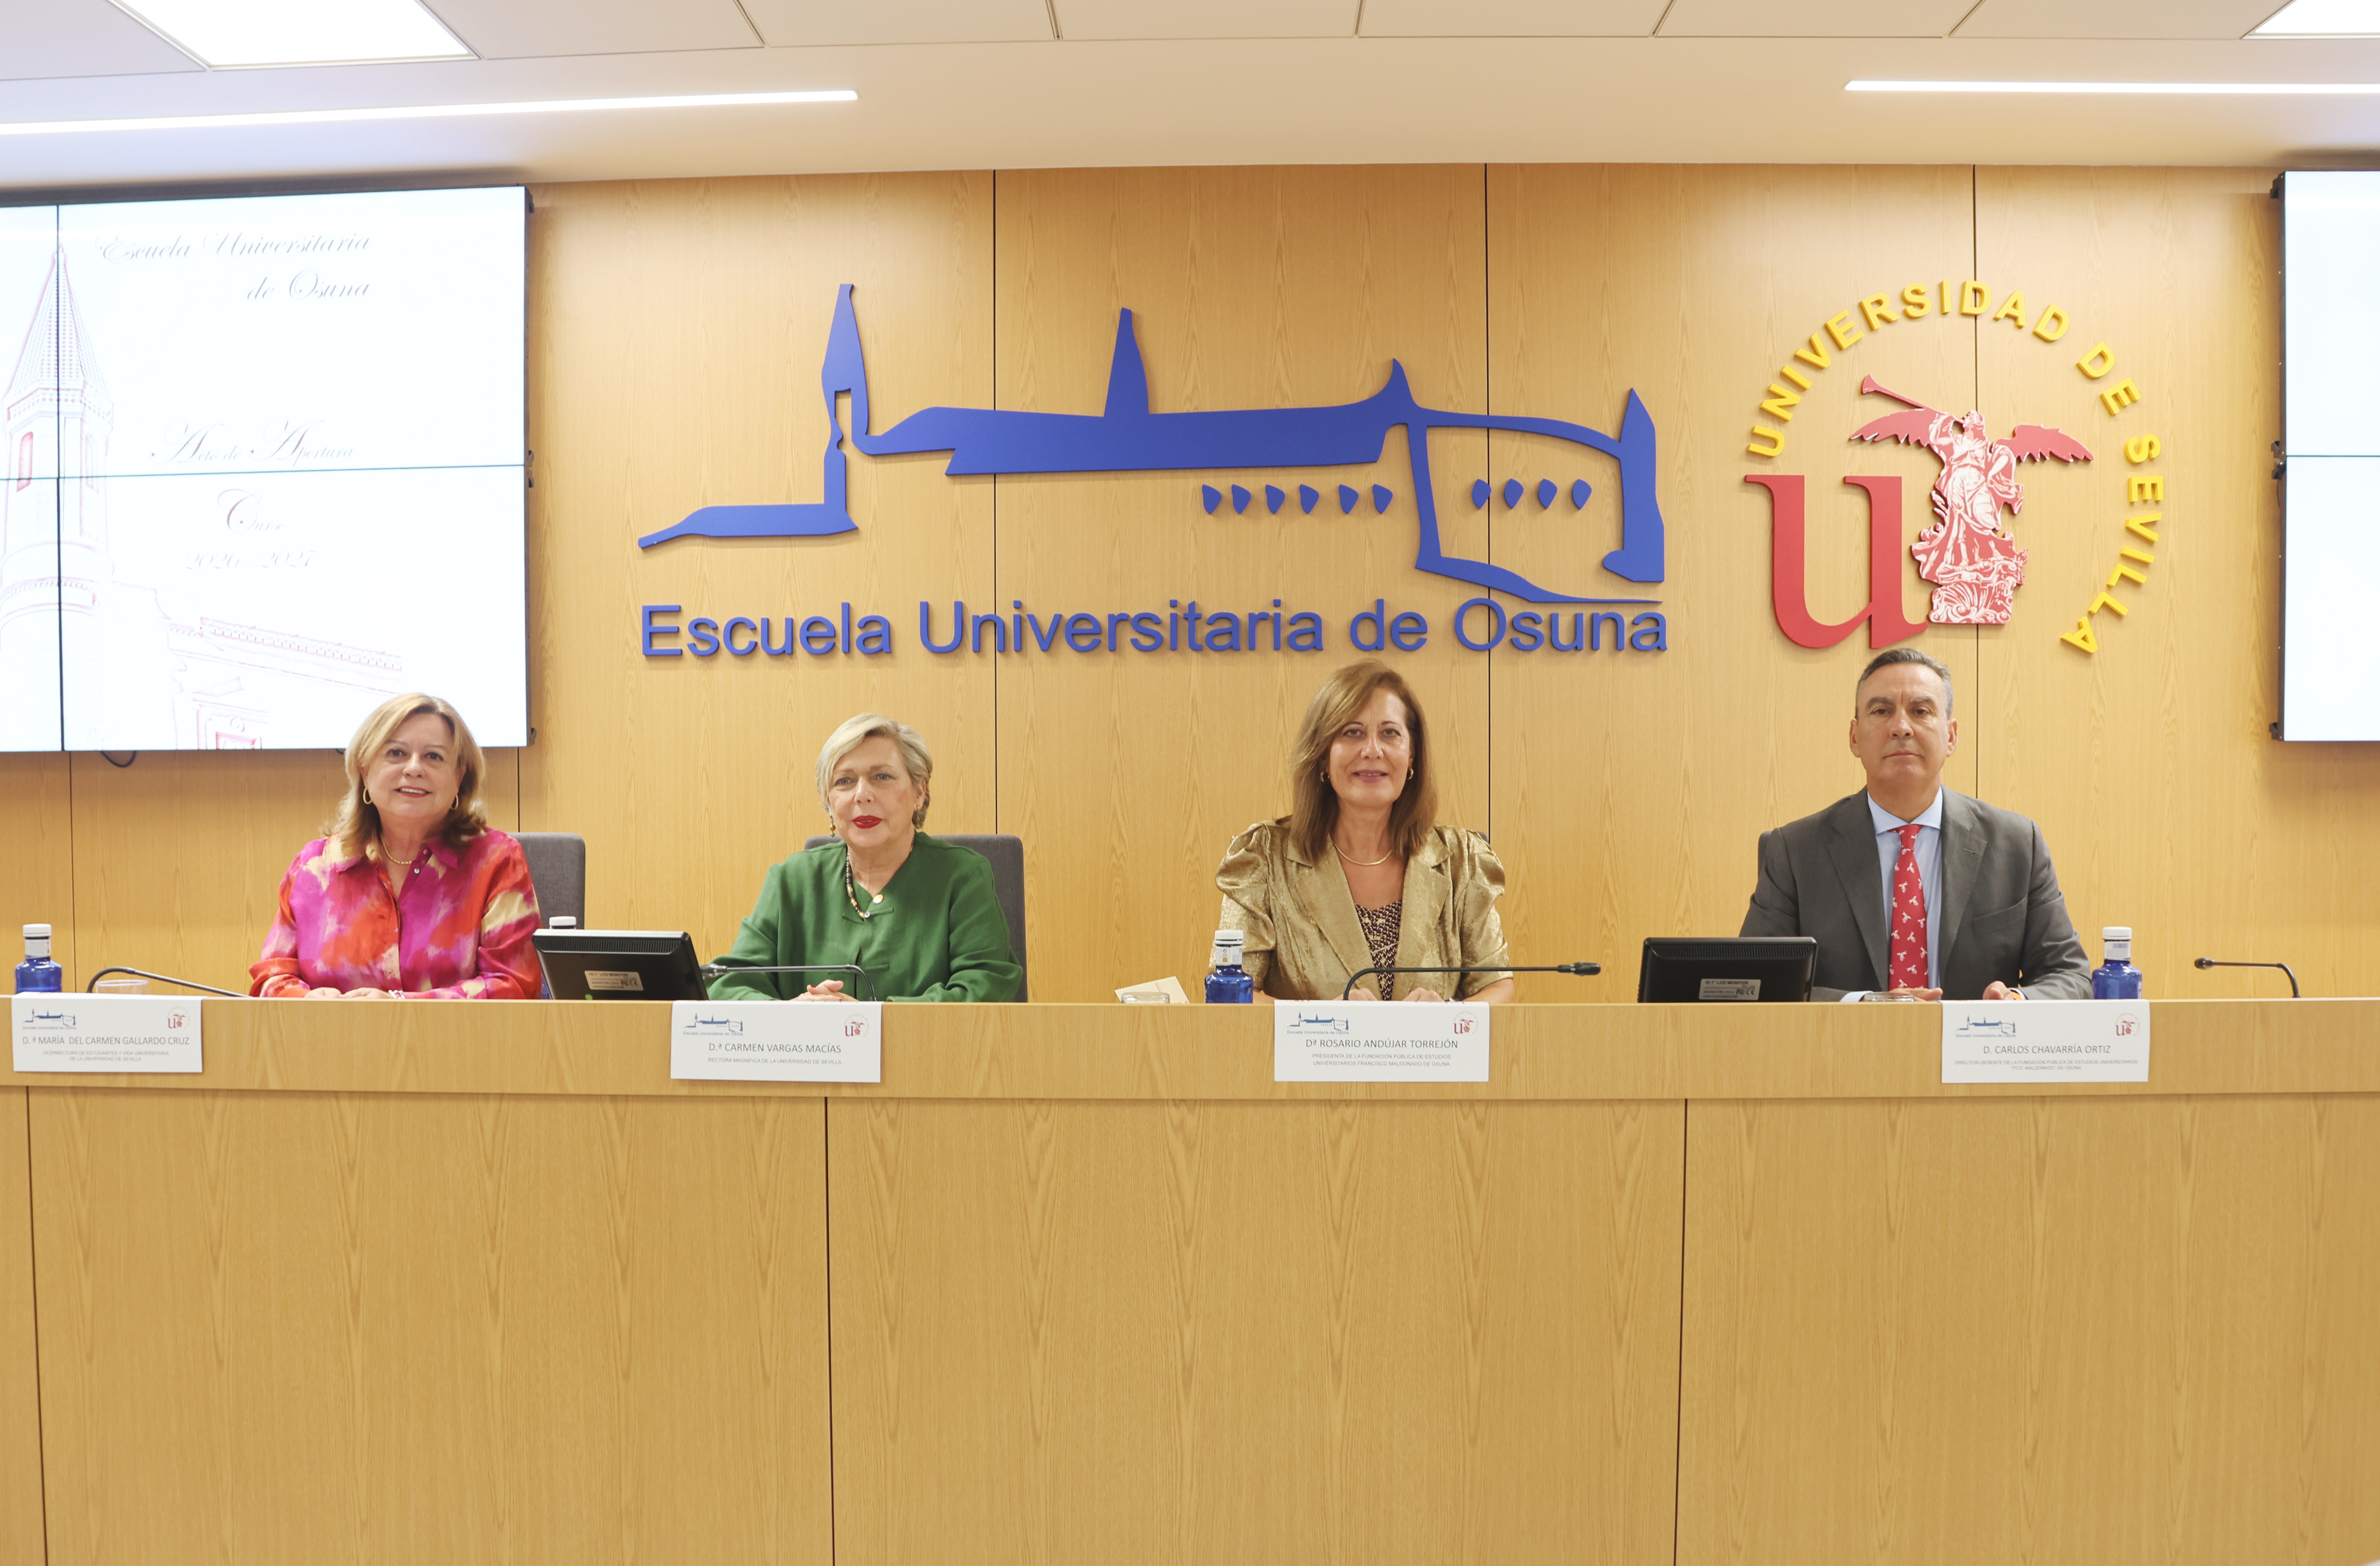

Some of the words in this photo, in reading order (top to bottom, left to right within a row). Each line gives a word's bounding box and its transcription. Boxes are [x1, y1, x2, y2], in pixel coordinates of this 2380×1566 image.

[95, 235, 191, 264] Escuela
[203, 232, 370, 259] Universitaria
[247, 276, 275, 301] de
[289, 268, 370, 301] Osuna
[1747, 279, 2069, 458] UNIVERSIDAD
[2077, 341, 2142, 415] DE
[150, 419, 225, 465] Acto
[223, 445, 241, 462] de
[249, 416, 354, 468] Apertura
[218, 489, 285, 533] Curso
[261, 549, 318, 569] 2027
[2061, 434, 2164, 654] SEVILLA
[642, 602, 892, 656] Escuela
[920, 599, 1324, 654] Universitaria
[1349, 599, 1428, 651] de
[1454, 598, 1668, 651] Osuna
[22, 1036, 30, 1045] D.
[38, 1035, 65, 1045] MARÍA
[69, 1036, 83, 1045] DEL
[85, 1036, 120, 1045] CARMEN
[122, 1037, 166, 1045] GALLARDO
[168, 1037, 190, 1045] CRUZ
[724, 1043, 764, 1052] CARMEN
[767, 1044, 803, 1053] VARGAS
[806, 1043, 841, 1053] MACÍAS
[1363, 1038, 1407, 1048] ANDÚJAR
[1410, 1038, 1458, 1048] TORREJÓN
[1984, 1046, 1992, 1054] D.
[1995, 1046, 2029, 1054] CARLOS
[2031, 1044, 2082, 1054] CHAVARRÍA
[2085, 1045, 2111, 1054] ORTIZ
